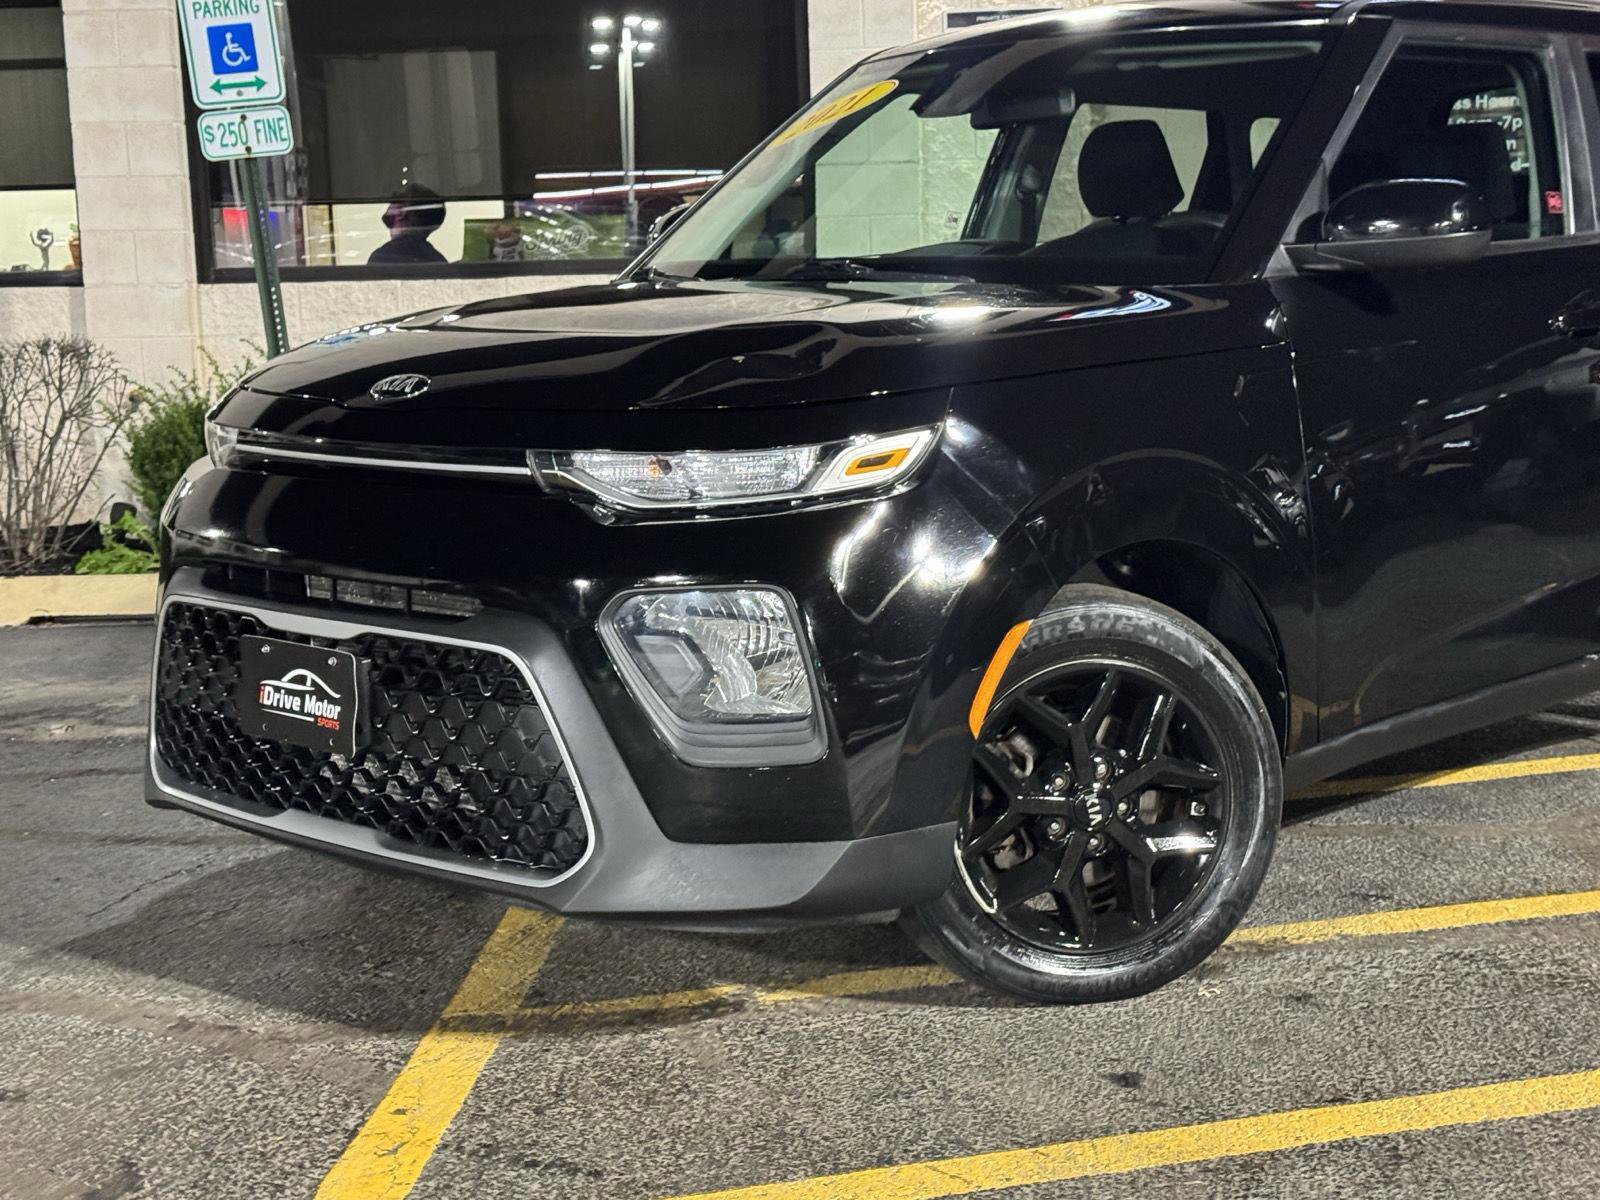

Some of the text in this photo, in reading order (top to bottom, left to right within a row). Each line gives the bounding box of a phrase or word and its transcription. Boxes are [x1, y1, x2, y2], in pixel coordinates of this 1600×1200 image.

[192, 0, 260, 19] PARKING
[204, 117, 288, 148] $250 FINE
[375, 377, 419, 393] KIA
[259, 685, 341, 720] iDrive Motor
[317, 717, 340, 731] SPORTS
[1084, 792, 1103, 827] KIA
